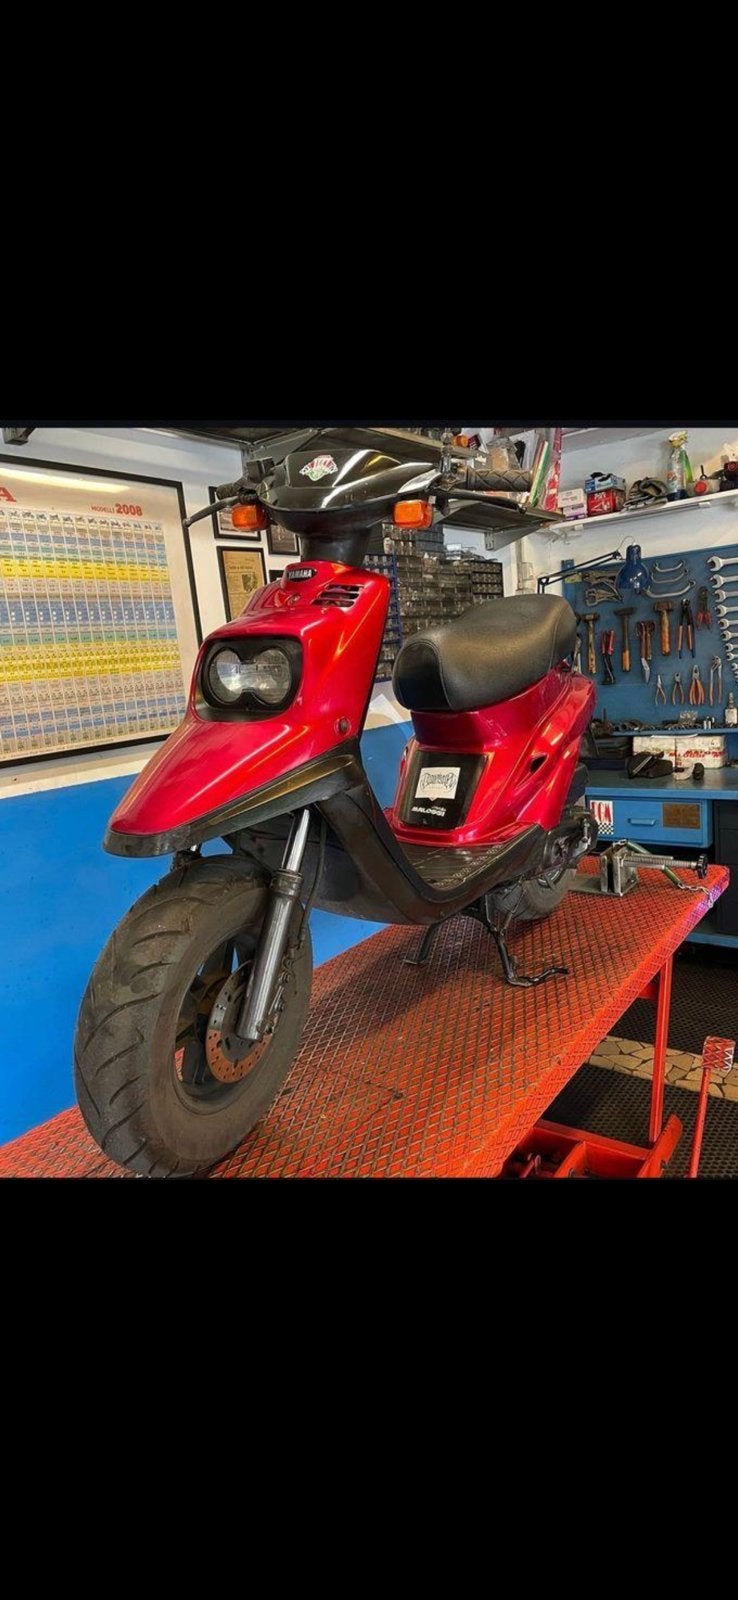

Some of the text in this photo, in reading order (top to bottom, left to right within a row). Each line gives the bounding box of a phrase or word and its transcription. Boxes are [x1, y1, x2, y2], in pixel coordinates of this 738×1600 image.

[115, 503, 143, 516] 2008
[288, 569, 312, 580] YAMAHA
[411, 806, 446, 817] MALOSSI
